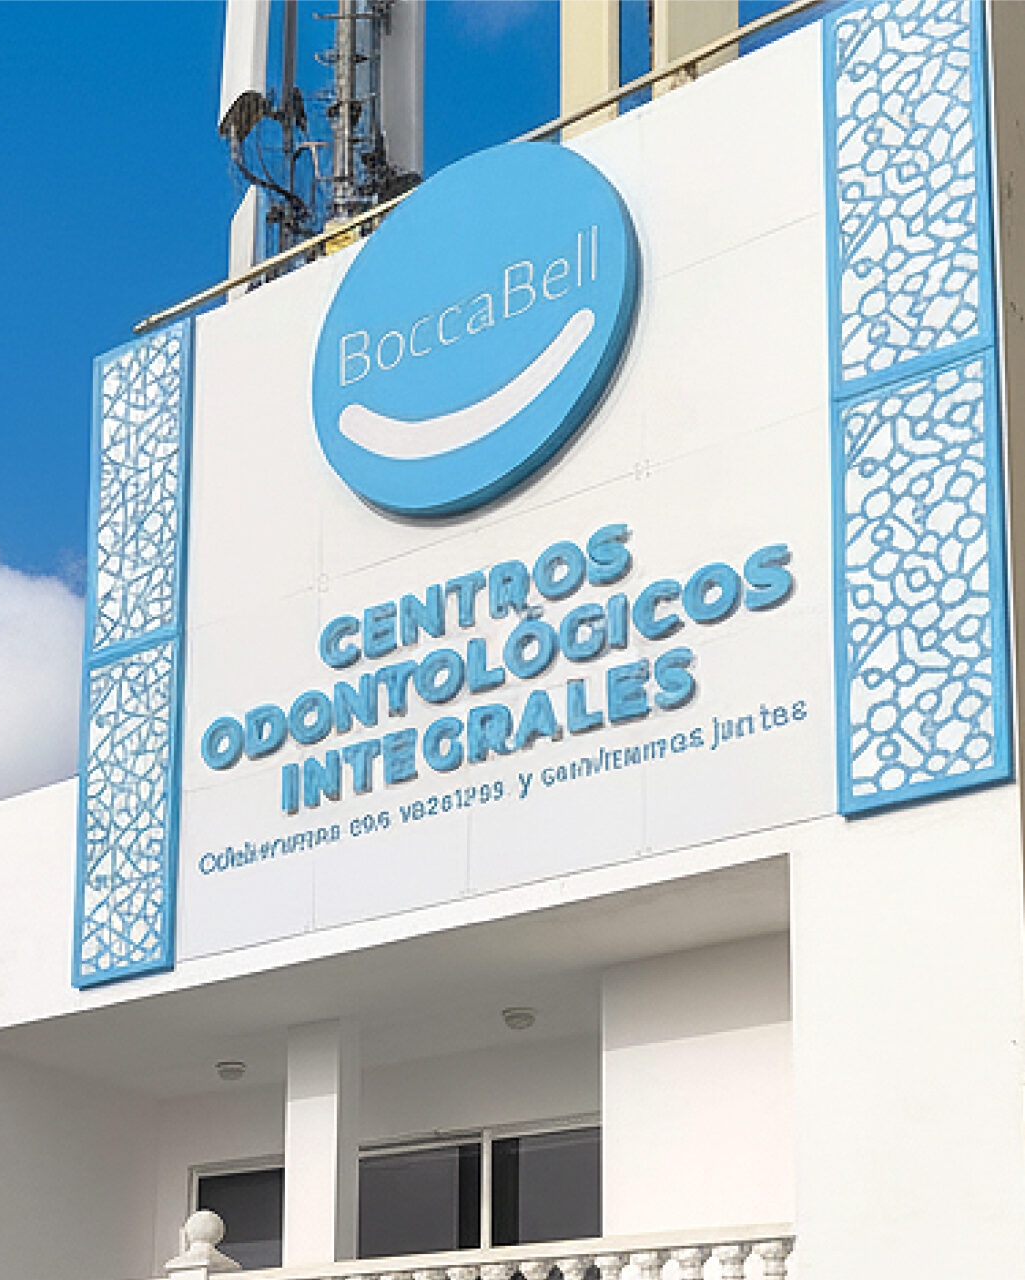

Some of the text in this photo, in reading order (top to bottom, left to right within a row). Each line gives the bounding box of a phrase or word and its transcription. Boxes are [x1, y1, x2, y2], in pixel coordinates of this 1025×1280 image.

[339, 224, 599, 387] BoccaBell
[319, 523, 632, 669] CENTROS
[281, 647, 699, 815] INTEGRALES
